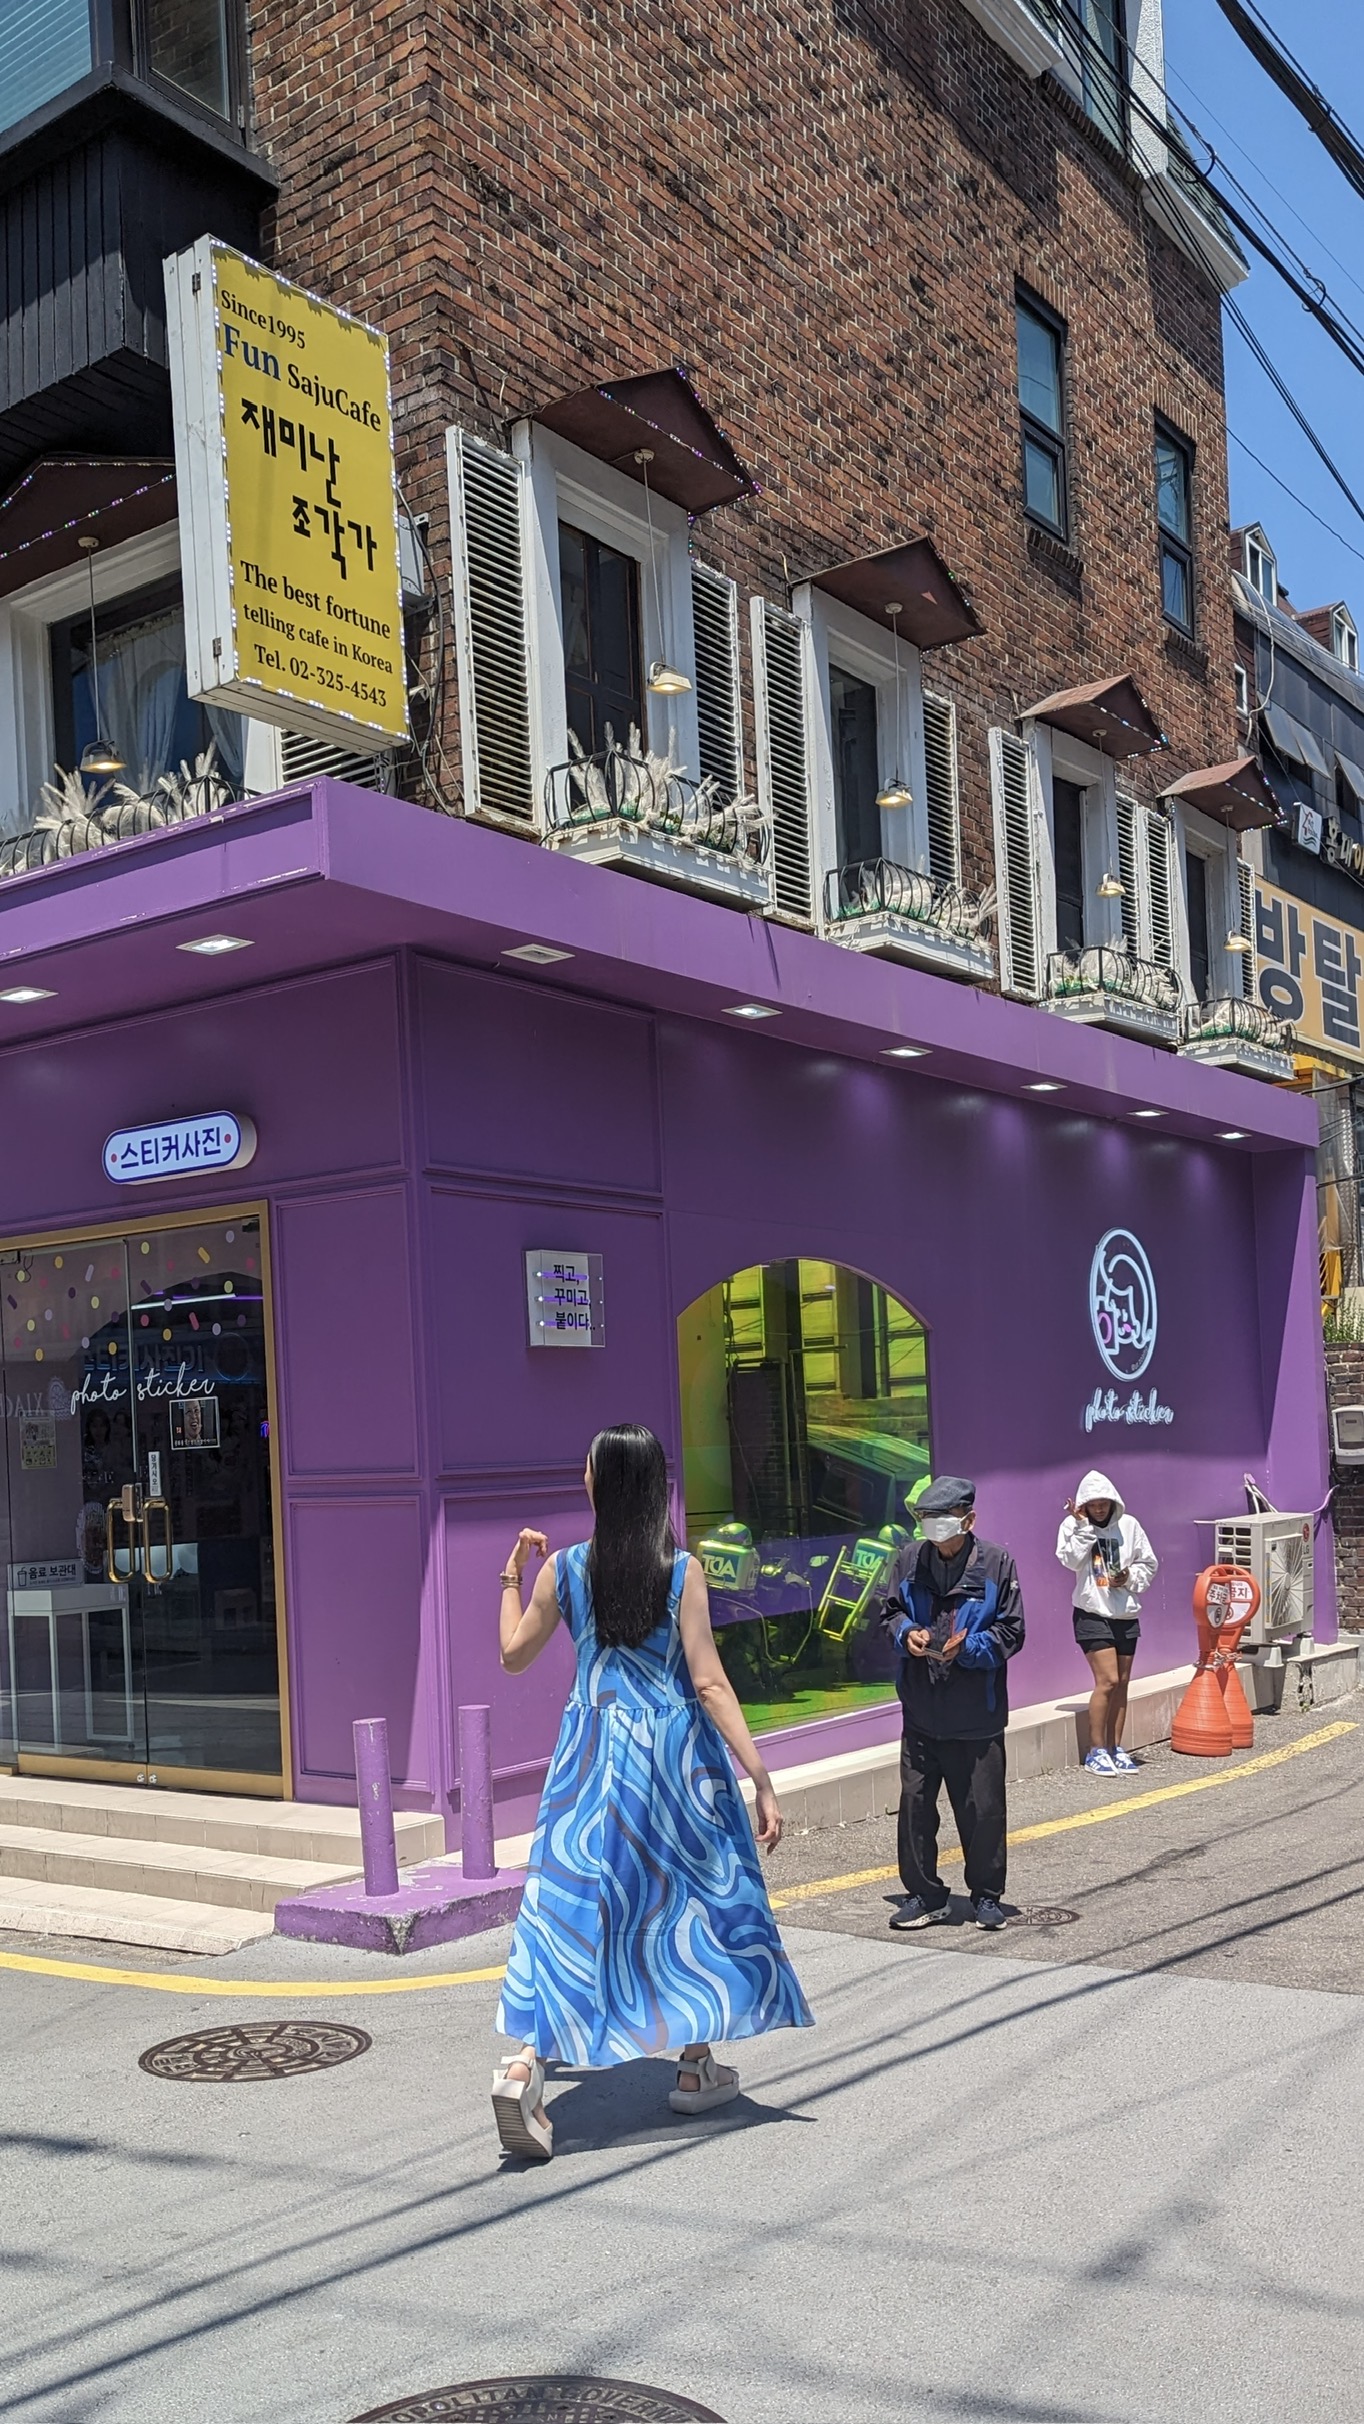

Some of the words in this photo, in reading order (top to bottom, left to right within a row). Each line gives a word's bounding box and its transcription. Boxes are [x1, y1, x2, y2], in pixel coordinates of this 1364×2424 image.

[221, 290, 305, 349] Since1995
[222, 323, 281, 381] Fun
[288, 363, 381, 432] SajuCafe
[241, 397, 340, 508] 재미난
[292, 495, 377, 580] 조각가
[240, 560, 278, 594] The
[282, 576, 321, 611] best
[326, 595, 391, 639] fortune
[243, 603, 295, 641] telling
[299, 626, 329, 650] cafe
[333, 636, 348, 657] in
[352, 644, 393, 674] Korea
[254, 643, 286, 672] Tel.
[290, 657, 387, 707] 02-325-4543
[121, 1127, 221, 1169] 스티커사진
[70, 1373, 127, 1415] photo
[137, 1362, 215, 1401] sticker
[49, 1563, 76, 1577] 보관대
[379, 2387, 545, 2424] OPOLITAN
